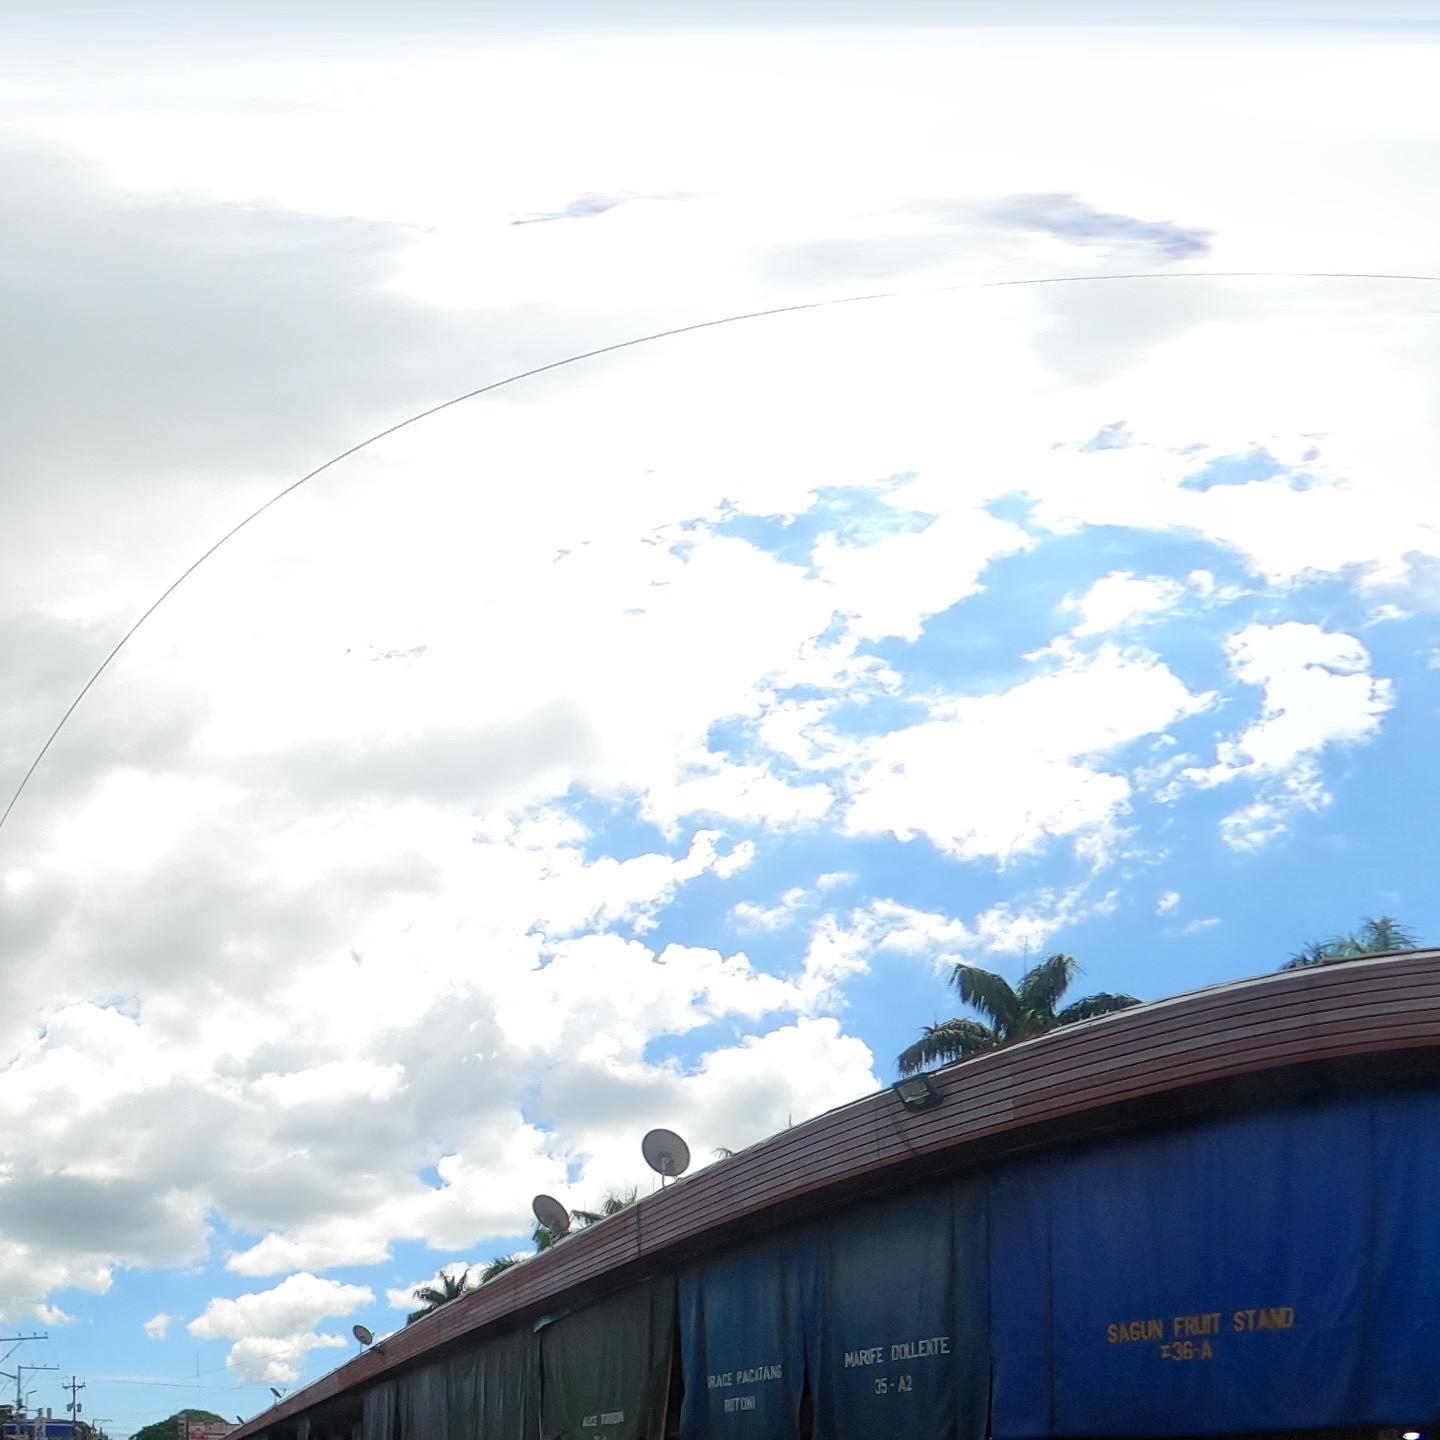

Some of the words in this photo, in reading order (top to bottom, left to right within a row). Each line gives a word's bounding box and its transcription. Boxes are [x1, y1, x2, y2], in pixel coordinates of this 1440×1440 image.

[1107, 1319, 1163, 1343] SAGUN
[1173, 1312, 1222, 1336] FRUIT
[1233, 1307, 1295, 1332] STAND
[844, 1347, 884, 1368] MARIFE
